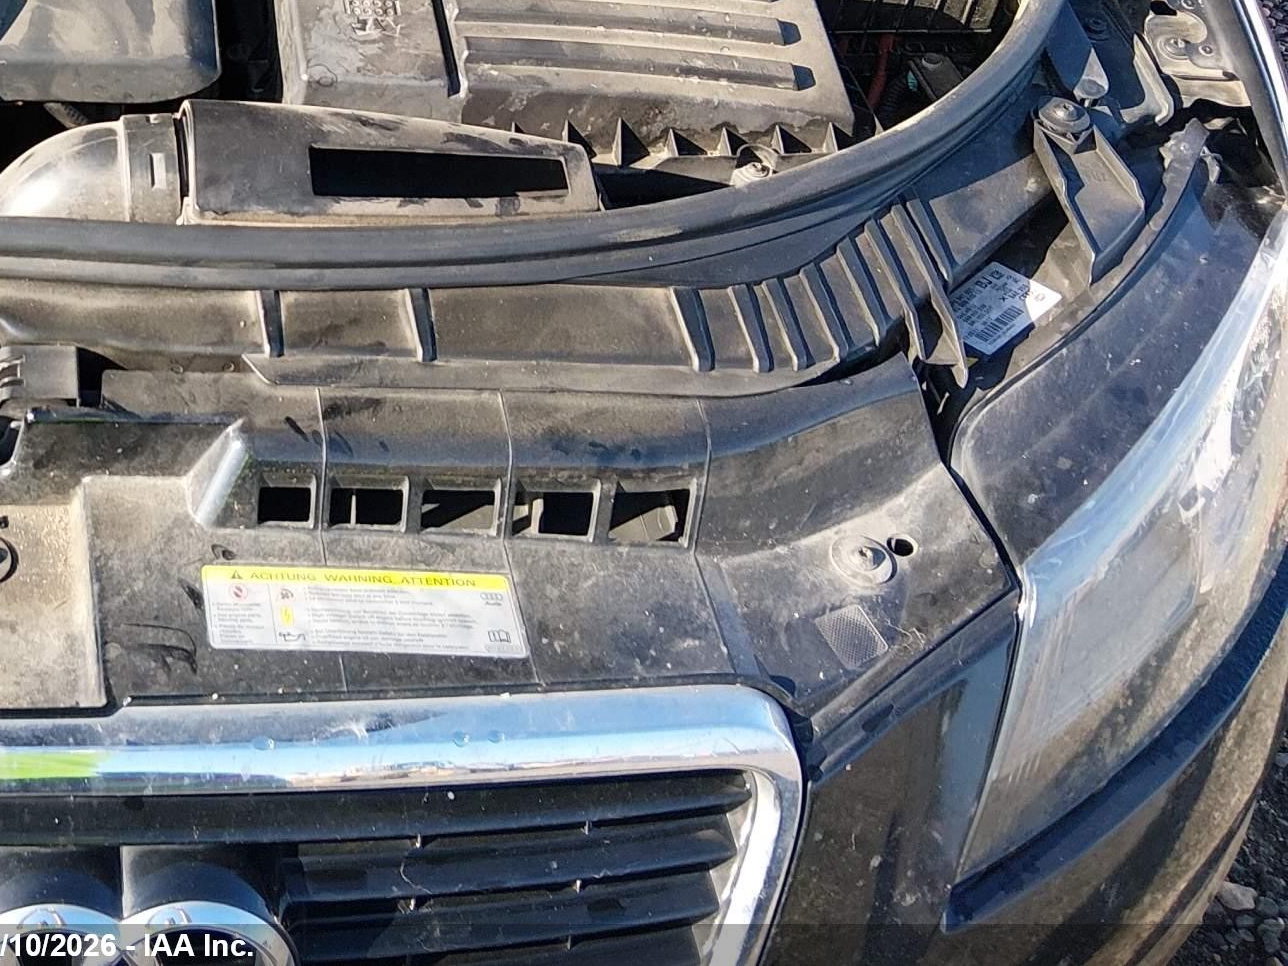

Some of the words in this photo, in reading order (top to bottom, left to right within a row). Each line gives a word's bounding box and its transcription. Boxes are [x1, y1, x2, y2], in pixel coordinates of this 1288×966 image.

[250, 571, 317, 582] ACHTUNG
[324, 573, 393, 585] WARNING
[401, 576, 477, 587] ATTENTION
